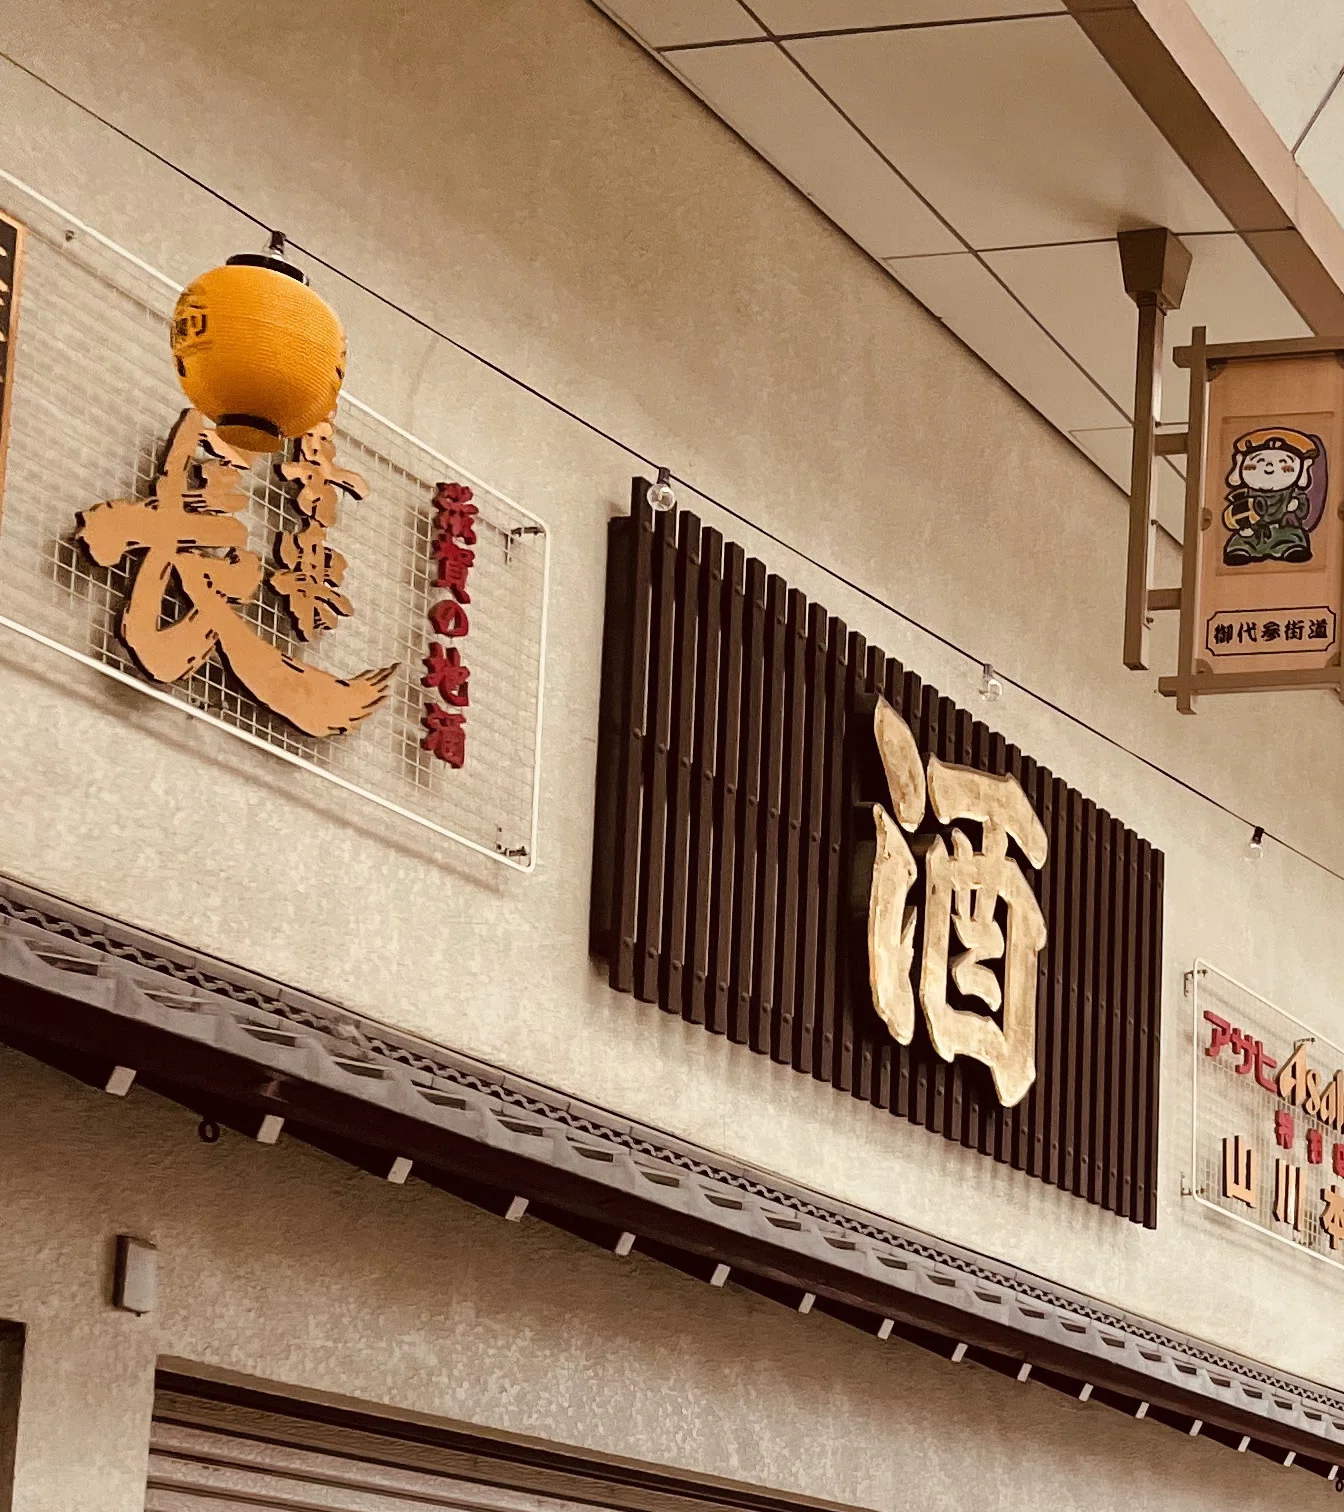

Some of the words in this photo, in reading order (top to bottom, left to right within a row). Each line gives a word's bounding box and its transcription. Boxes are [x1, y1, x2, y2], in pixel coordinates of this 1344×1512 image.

[420, 481, 480, 770] 滋賀の地酒
[1213, 619, 1328, 645] 御代参街道
[866, 692, 1049, 1108] 酒
[1203, 1009, 1278, 1094] アサヒ
